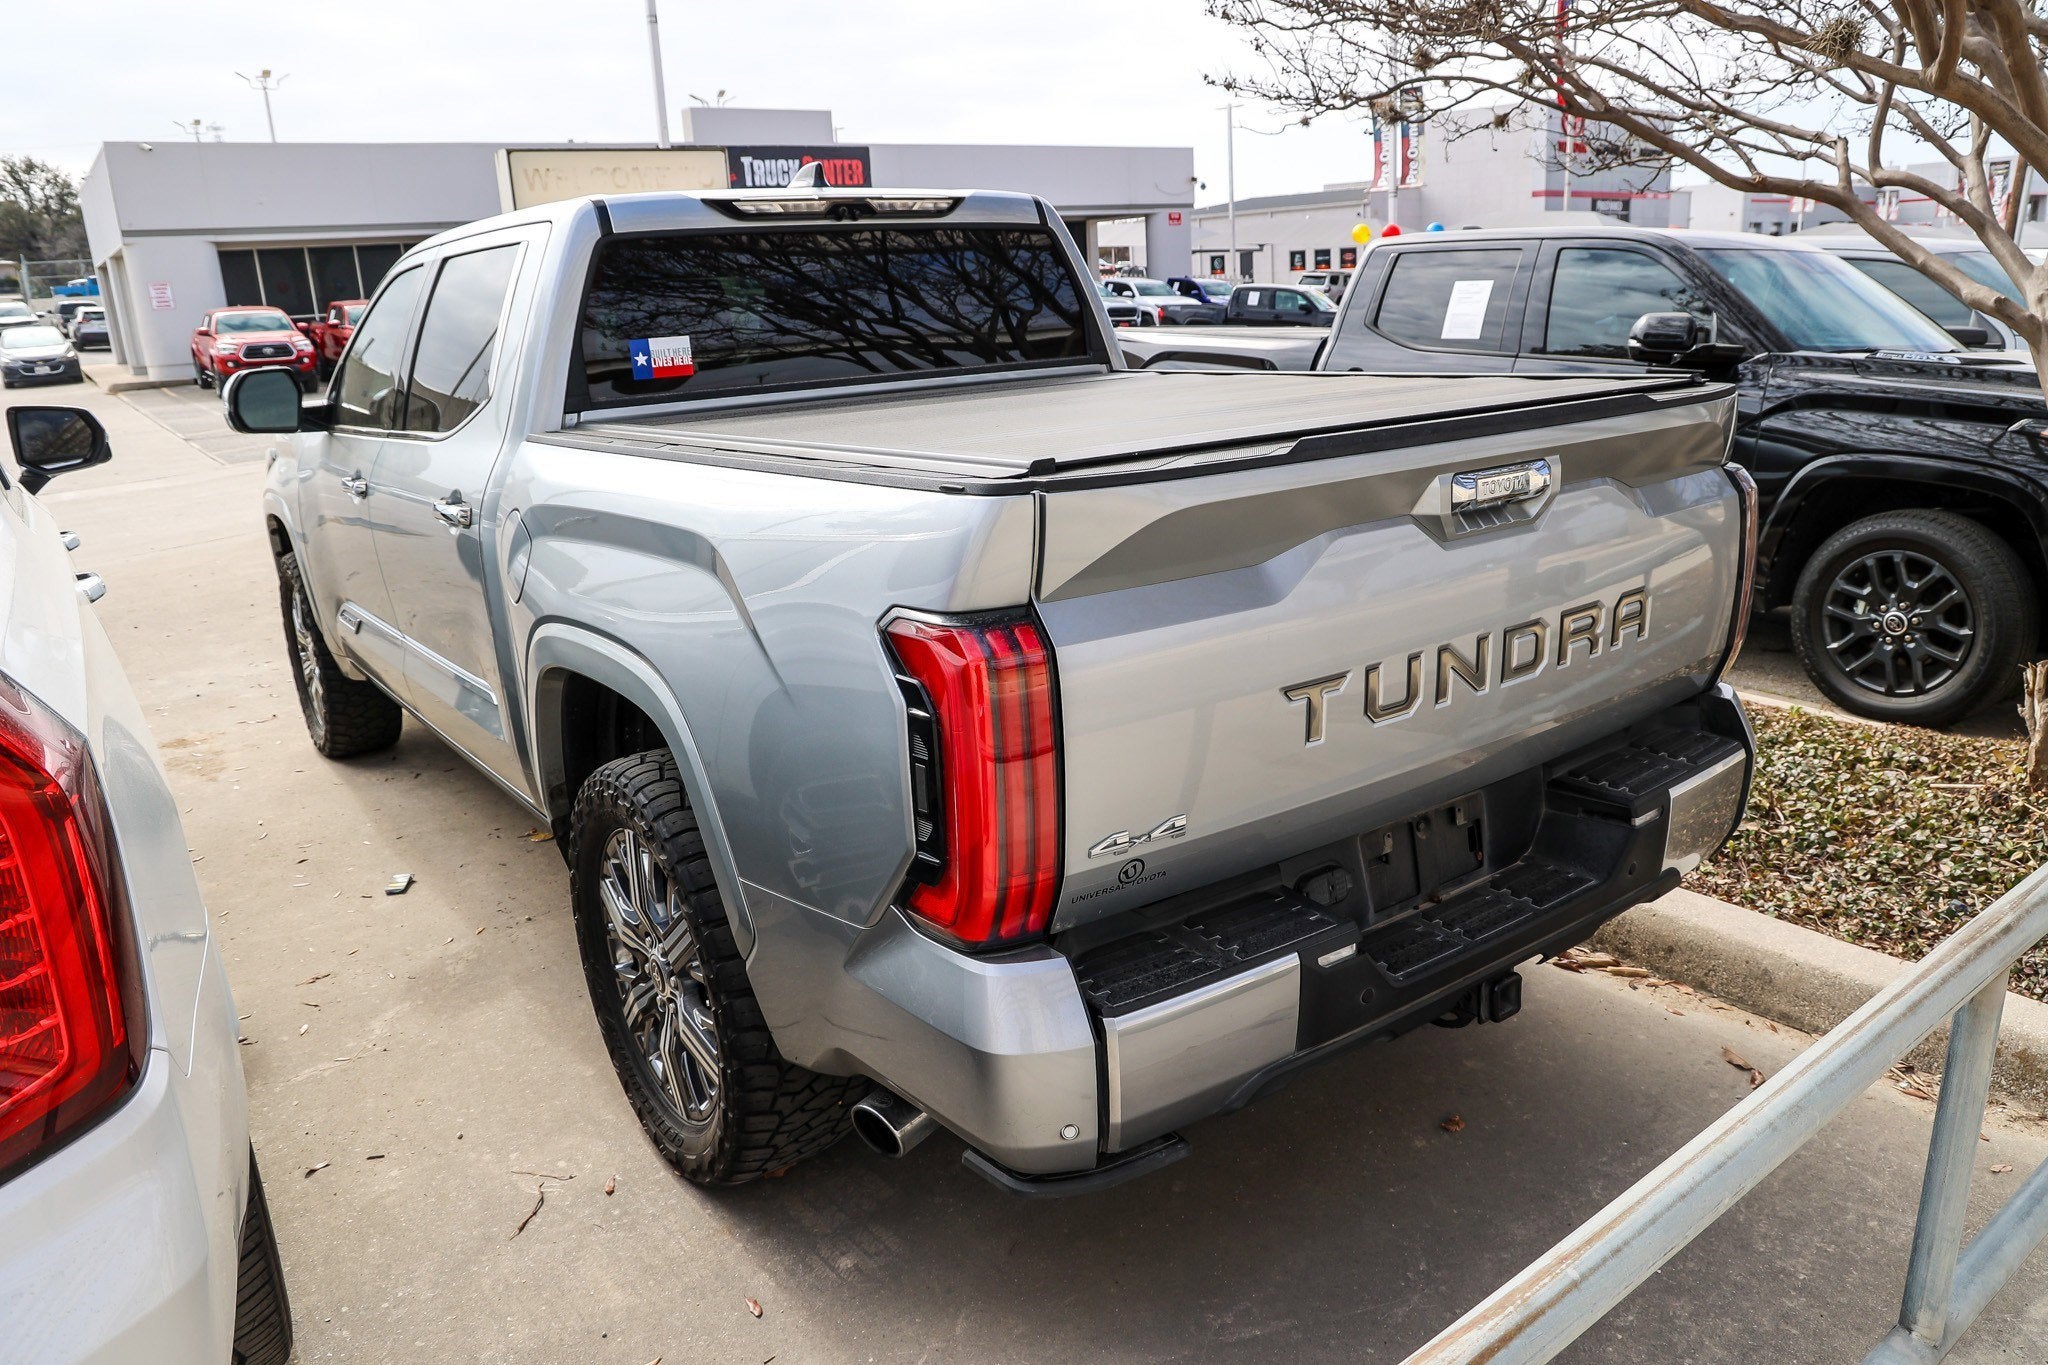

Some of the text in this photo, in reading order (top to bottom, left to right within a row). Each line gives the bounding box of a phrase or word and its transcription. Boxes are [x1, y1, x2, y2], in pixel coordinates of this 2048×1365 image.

[740, 156, 801, 187] TRUCK
[802, 155, 865, 186] NTER
[650, 346, 692, 359] BUILT HERE
[651, 355, 693, 368] LIVES HERE
[1481, 474, 1528, 496] TOYOTA
[1279, 585, 1653, 748] TUNDRA
[1071, 870, 1168, 904] UNIVERSAL TOYOTA
